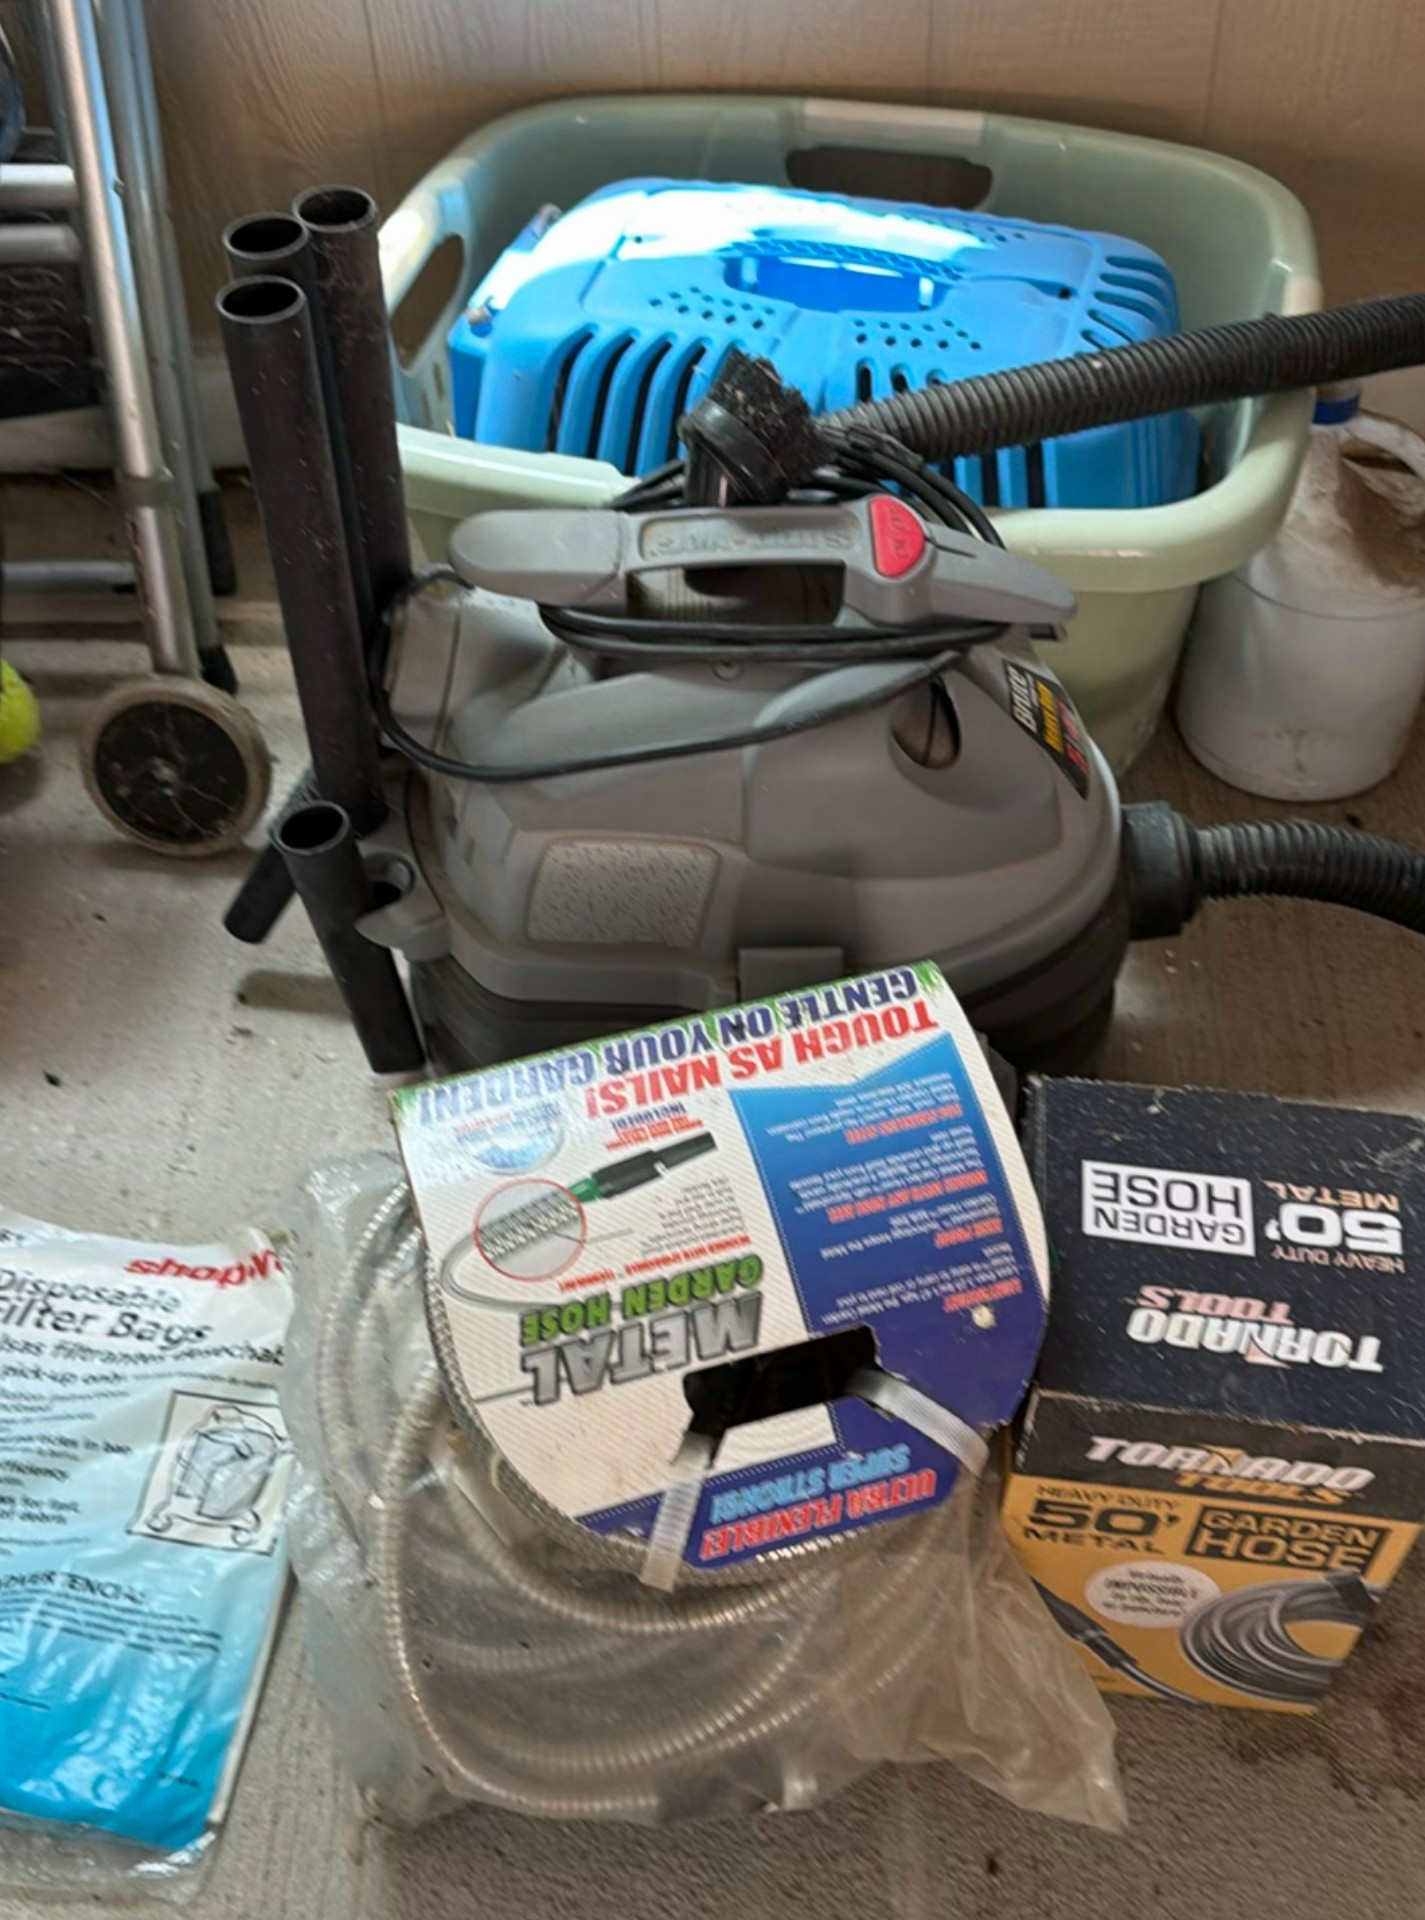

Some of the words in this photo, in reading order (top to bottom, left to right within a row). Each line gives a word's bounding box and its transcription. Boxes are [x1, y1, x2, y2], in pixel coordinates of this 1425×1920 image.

[780, 968, 916, 1029] GENTLE
[601, 1021, 713, 1077] YOUR
[719, 1007, 773, 1045] ON
[791, 1000, 938, 1065] TOUGH
[728, 1038, 783, 1080] AS
[419, 1051, 594, 1125] GARDEN!
[584, 1056, 721, 1119] NAILS!
[1089, 1169, 1243, 1219] HOSE
[1262, 1179, 1400, 1212] METAL
[1093, 1205, 1246, 1247] GARDEN
[1263, 1202, 1403, 1255] 50'
[1271, 1245, 1330, 1265] DUTY
[1334, 1253, 1405, 1273] HEAVY
[0, 1269, 180, 1313] Disposable
[622, 1254, 763, 1320] GARDEN
[1134, 1284, 1293, 1325] TOOLS
[107, 1311, 213, 1350] Bags
[520, 1292, 611, 1348] HOSE
[1126, 1307, 1383, 1373] TORNADO
[520, 1291, 763, 1407] METAL
[827, 1442, 911, 1490] SUPER
[1086, 1436, 1376, 1490] TORNADO
[708, 1465, 825, 1525] STRONG!
[845, 1468, 937, 1519] ULTRA
[1176, 1473, 1352, 1505] TOOLS
[698, 1495, 843, 1561] FLEXIBLE!
[1023, 1527, 1165, 1555] METAL
[1028, 1499, 1181, 1537] 50'
[1202, 1510, 1379, 1548] GARDEN
[1193, 1533, 1371, 1569] HOSE
